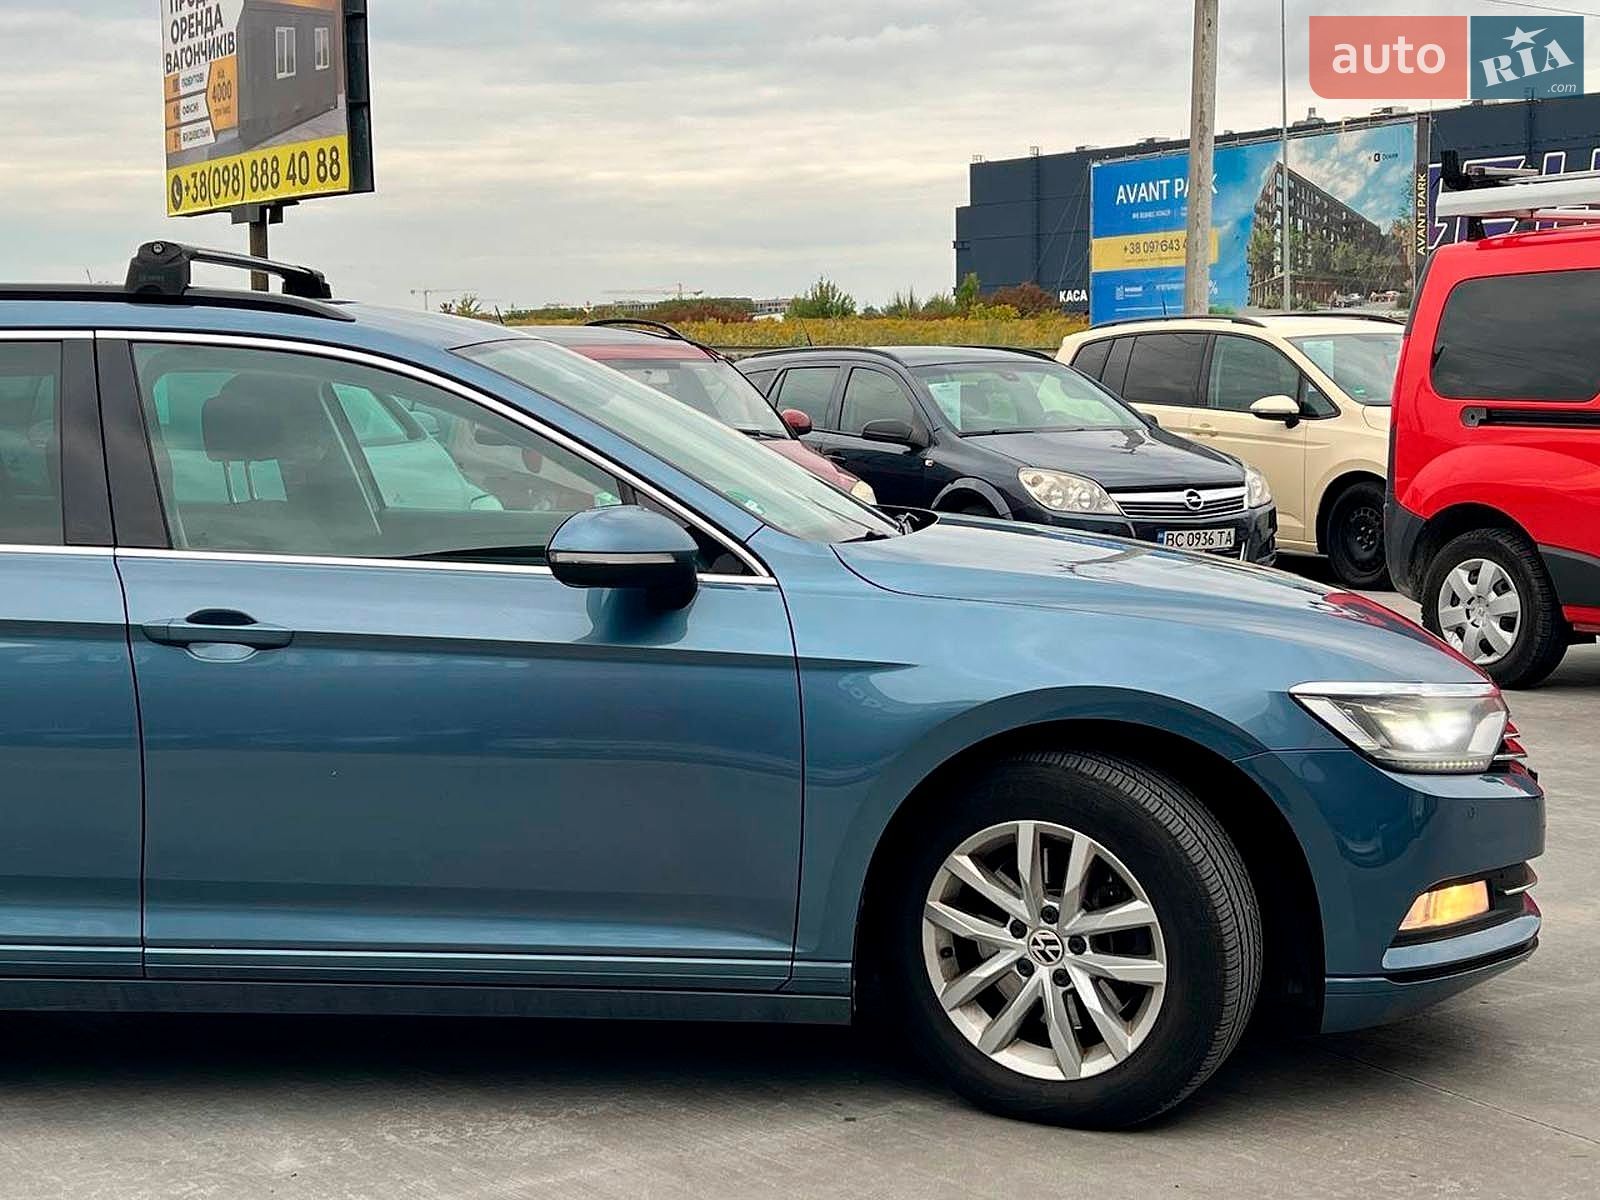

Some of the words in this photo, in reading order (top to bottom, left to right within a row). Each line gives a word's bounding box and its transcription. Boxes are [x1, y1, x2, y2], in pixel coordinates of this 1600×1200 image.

[170, 3, 223, 44] ОРЕНДА
[165, 31, 235, 74] ВАГОНЧИКІВ
[212, 79, 232, 103] 4000
[185, 158, 246, 206] +38(098)
[250, 155, 280, 192] 888
[286, 150, 310, 186] 40
[316, 145, 341, 184] 88
[1116, 179, 1170, 205] AVANT
[1416, 173, 1426, 207] PARK
[1416, 211, 1426, 256] AVANT
[1059, 289, 1088, 303] КАСА
[1166, 532, 1184, 547] BC
[1187, 530, 1215, 547] 0936
[1217, 530, 1233, 545] TA
